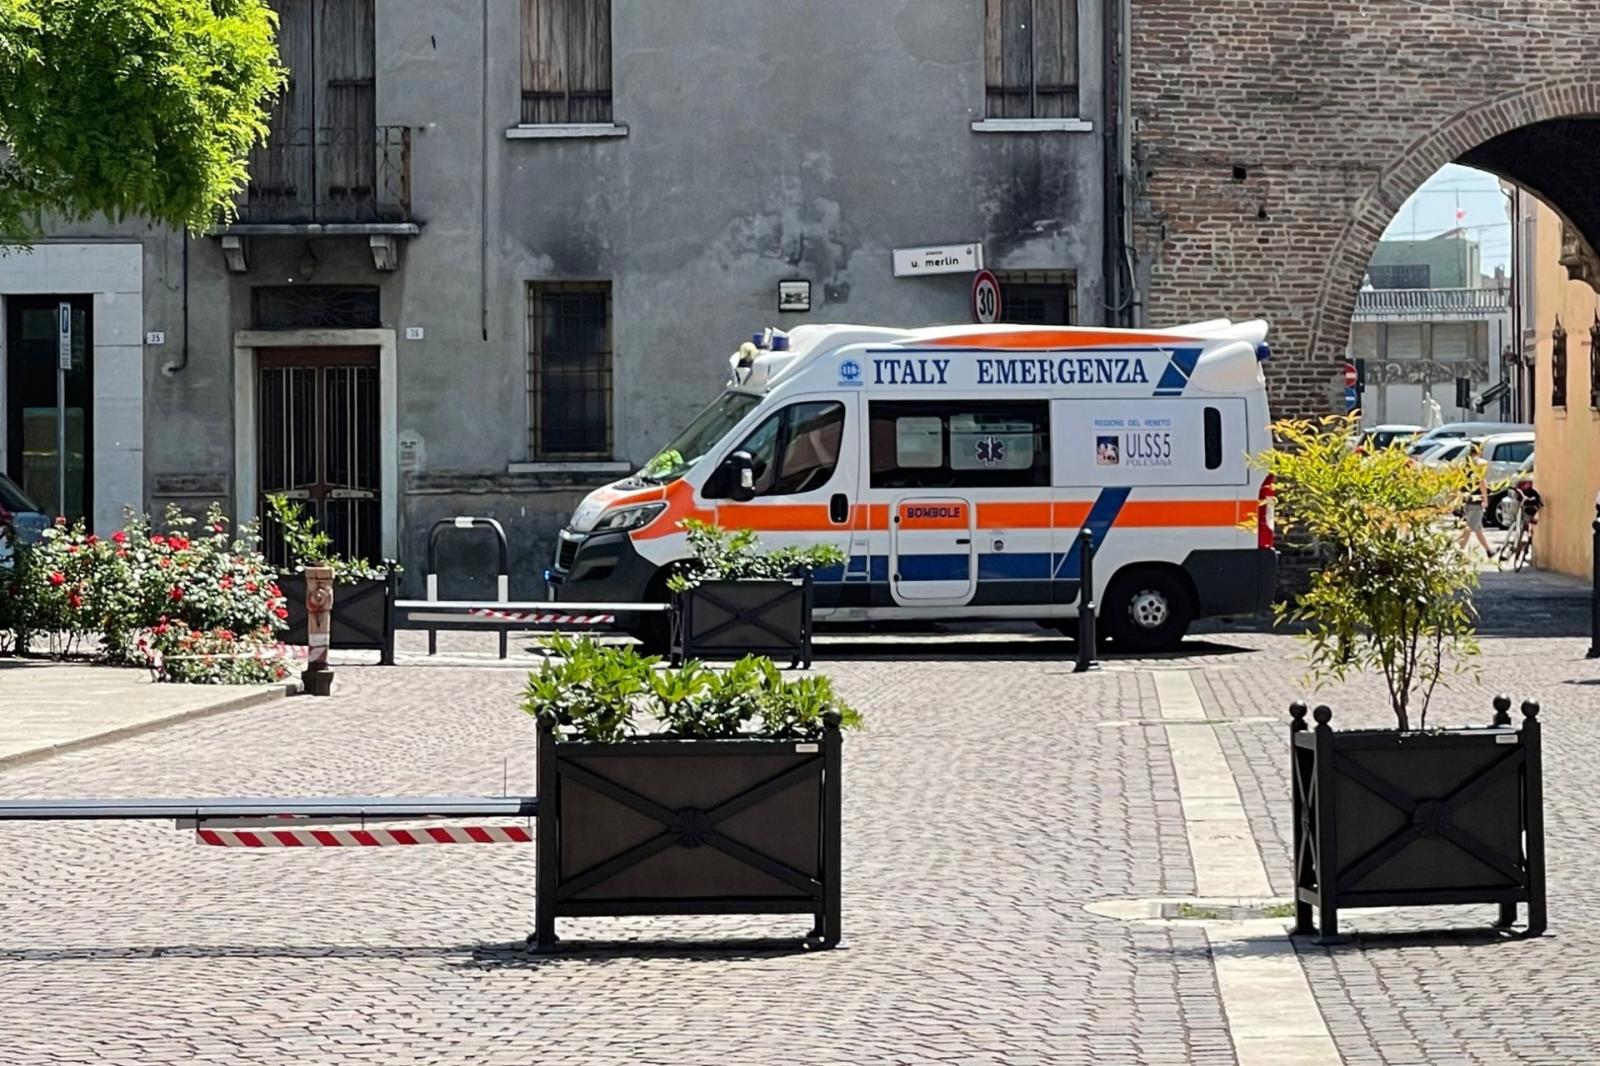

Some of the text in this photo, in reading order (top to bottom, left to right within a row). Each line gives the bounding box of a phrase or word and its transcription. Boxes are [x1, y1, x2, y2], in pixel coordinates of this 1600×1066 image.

[925, 257, 959, 267] merlin
[978, 287, 995, 316] 30
[843, 365, 857, 375] 118
[873, 358, 1149, 384] ITALY EMERGENZA
[1094, 419, 1171, 427] REGIONE DEL VENETO
[907, 507, 960, 518] BOMBOLE
